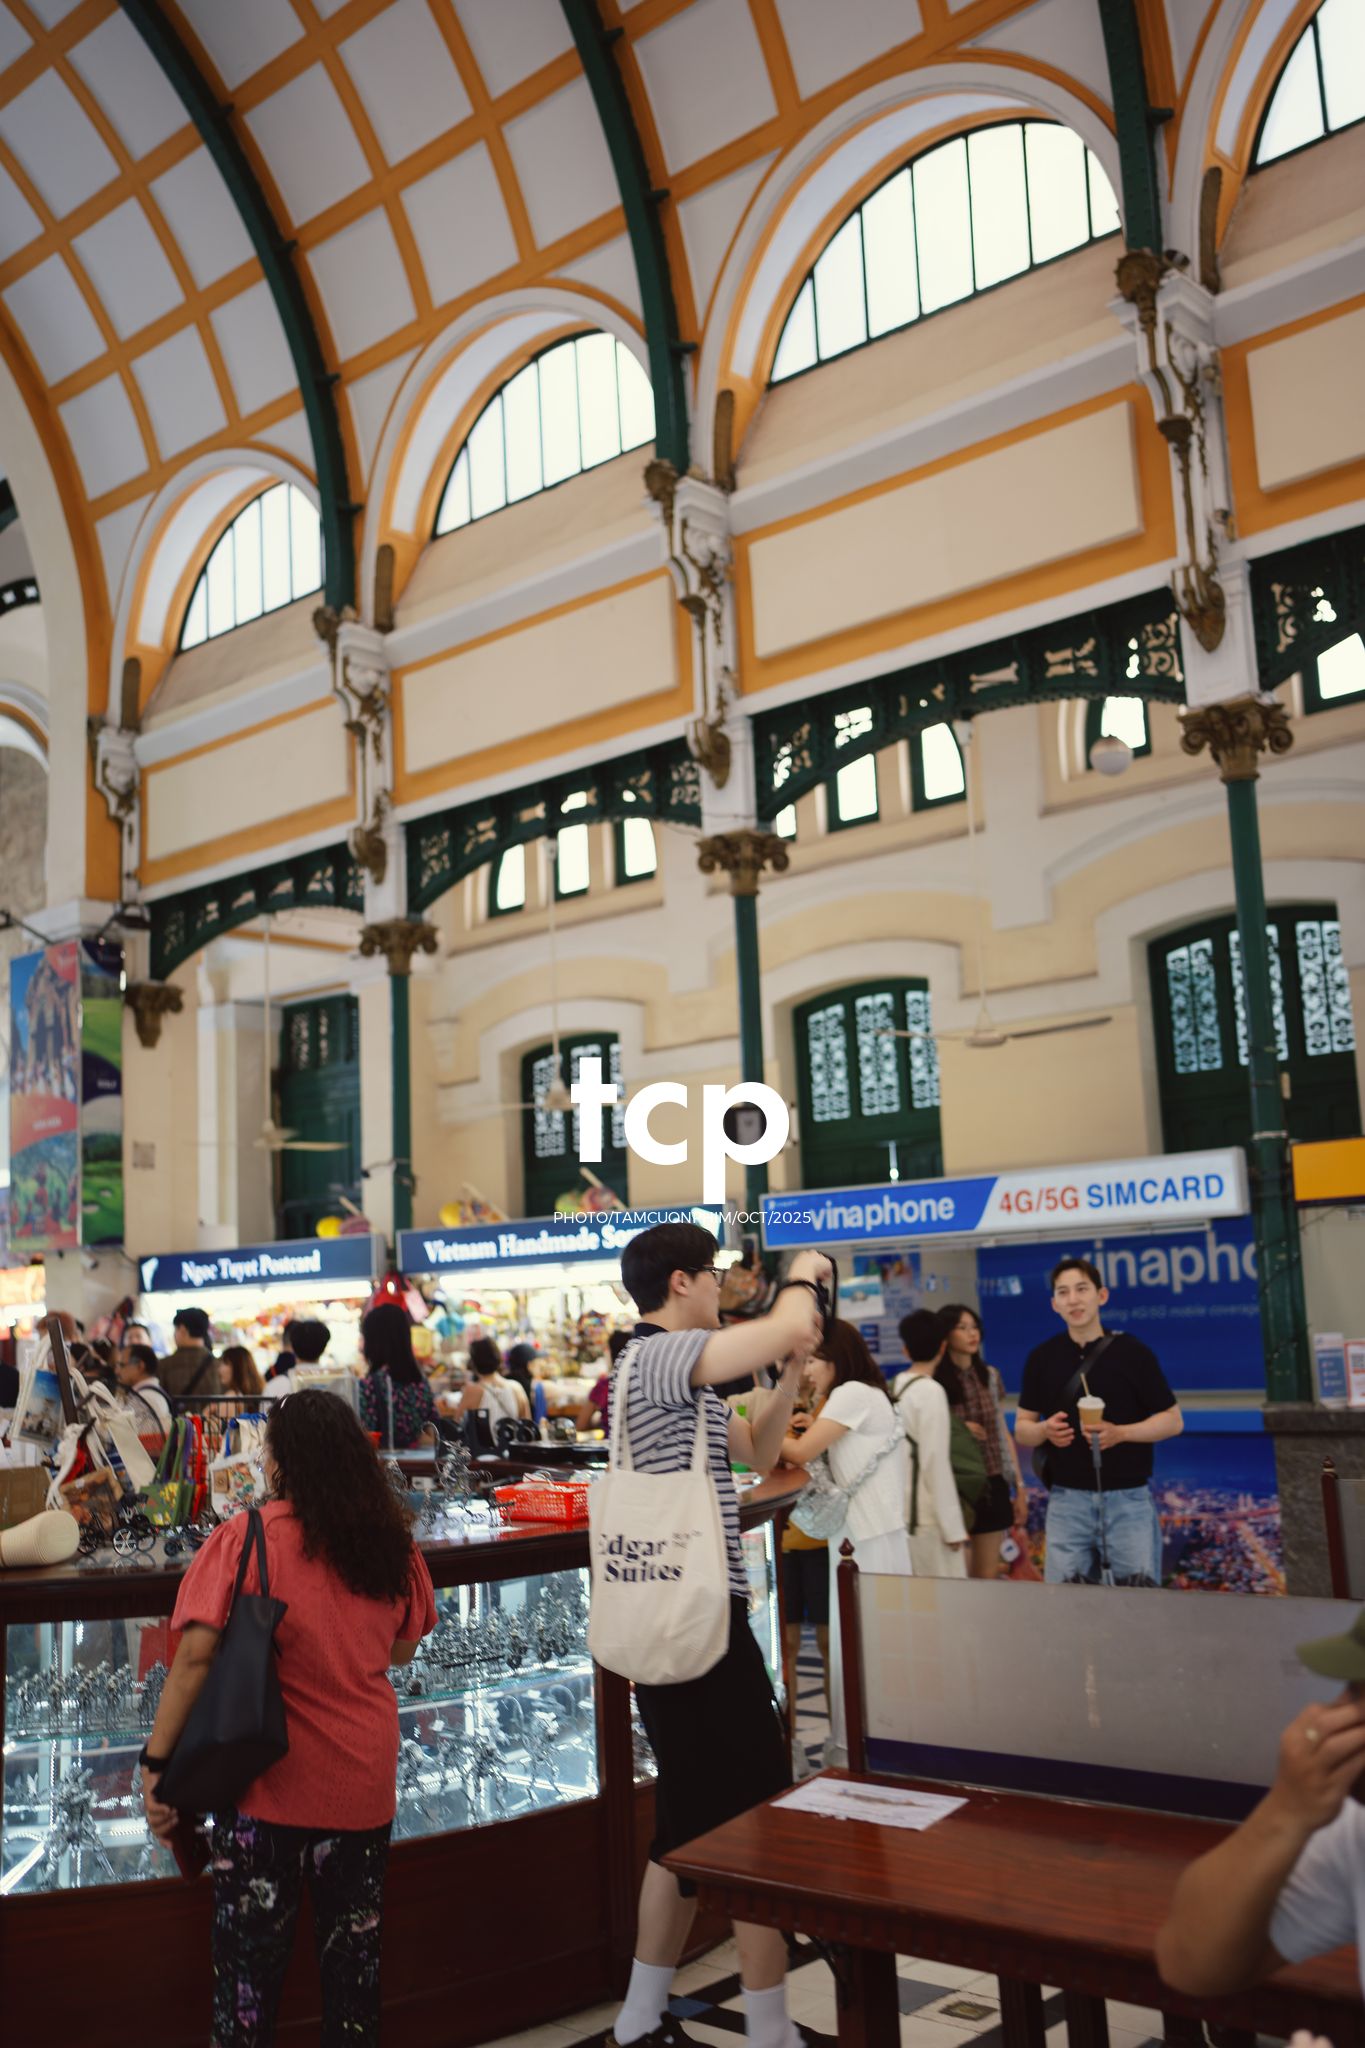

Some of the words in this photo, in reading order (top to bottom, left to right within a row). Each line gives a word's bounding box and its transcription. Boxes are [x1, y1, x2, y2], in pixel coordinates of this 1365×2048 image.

[811, 1195, 955, 1231] vinaphone
[999, 1186, 1080, 1215] 4G/5G
[1087, 1174, 1225, 1209] SIMCARD
[424, 1239, 497, 1264] Vietnam
[498, 1227, 600, 1258] Handmade
[259, 1249, 322, 1277] Postcard
[605, 1559, 684, 1583] Suites
